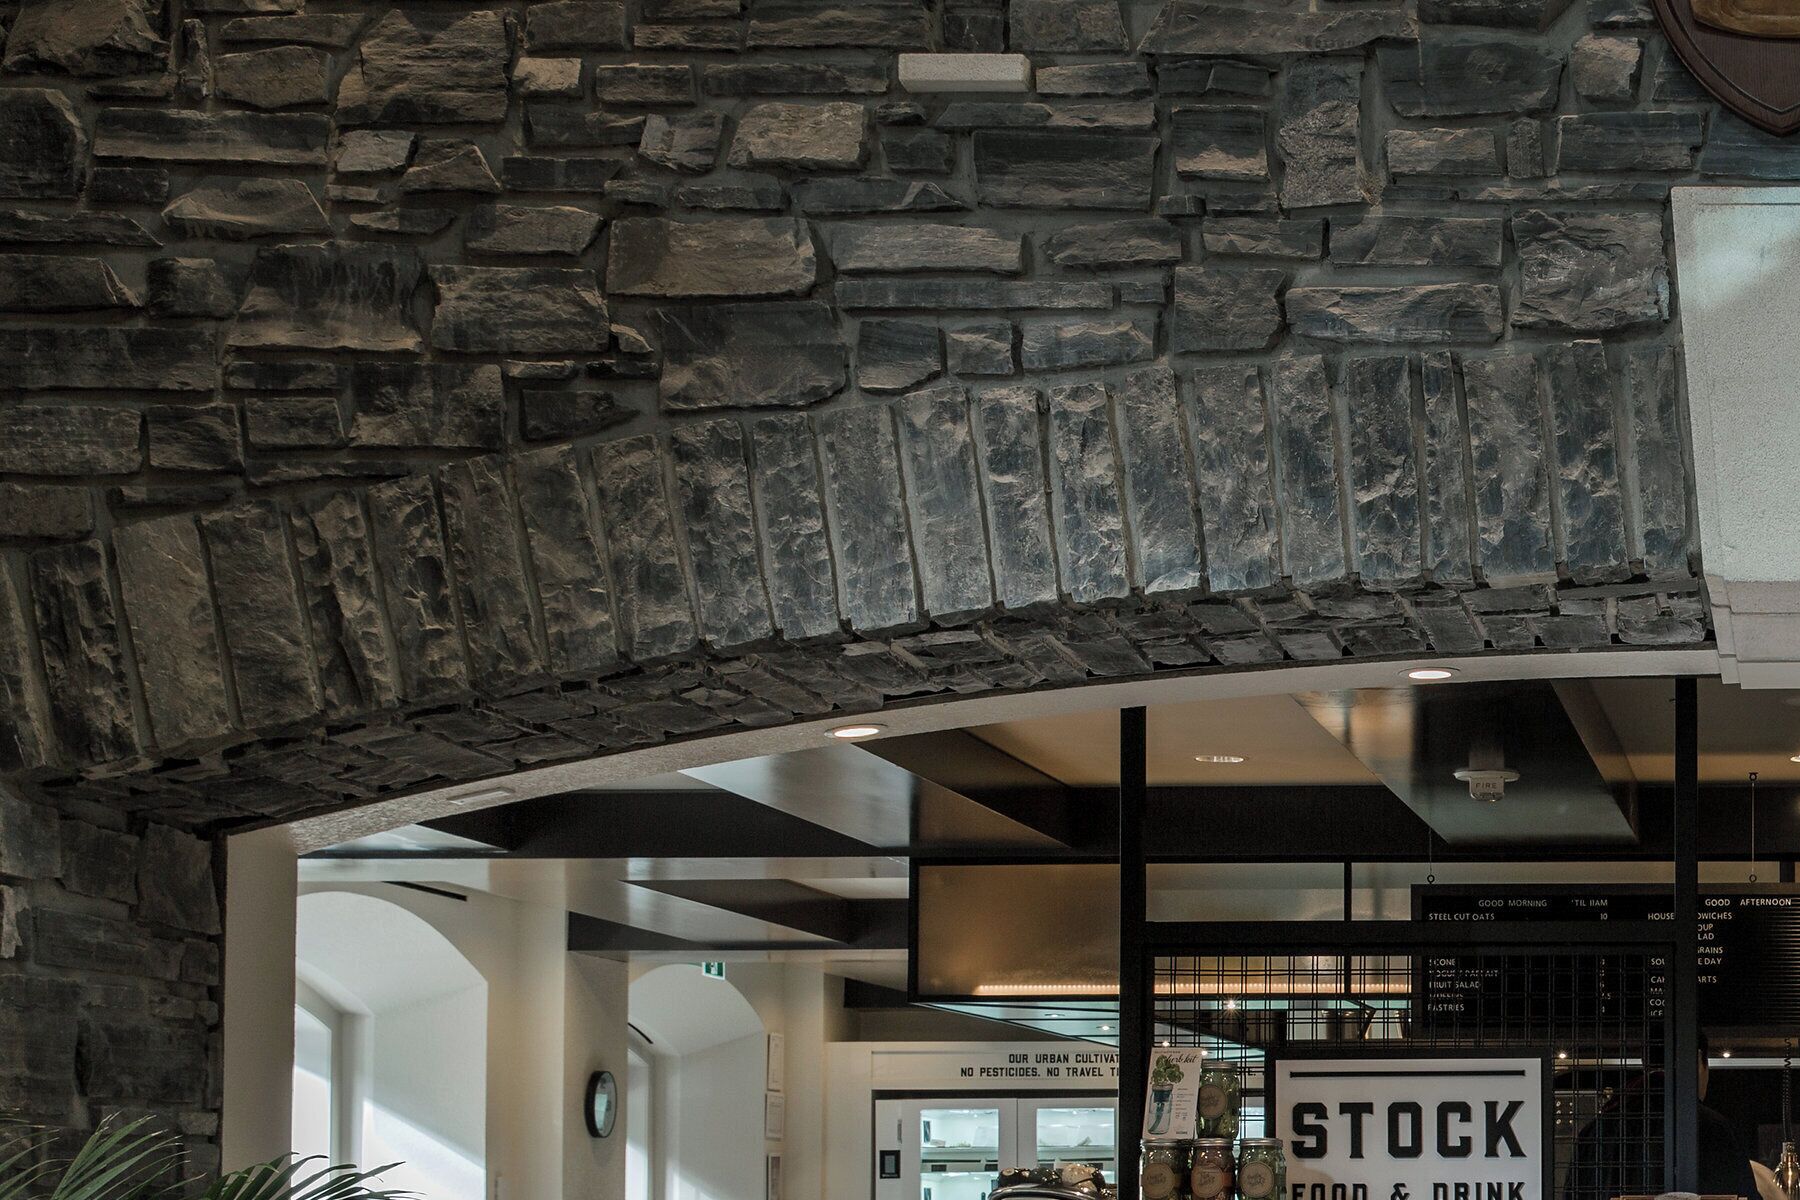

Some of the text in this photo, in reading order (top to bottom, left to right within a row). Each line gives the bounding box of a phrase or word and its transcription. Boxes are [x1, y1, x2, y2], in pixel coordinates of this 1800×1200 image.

[1478, 899, 1504, 907] GOOD
[1508, 899, 1548, 907] MORNING
[1704, 898, 1792, 907] GOOD AFTERNOON
[1428, 913, 1608, 921] STEEL CUT OATS 10
[1647, 912, 1675, 921] HOUSE
[1704, 957, 1722, 965] DAY
[1455, 981, 1481, 989] SALAD
[1009, 1053, 1119, 1064] OUR URBAN CULTIVAT
[1184, 1054, 1198, 1064] kit
[960, 1067, 1104, 1077] NO PESTICIDES. NO TRAVEL
[1290, 1100, 1529, 1159] STOCK
